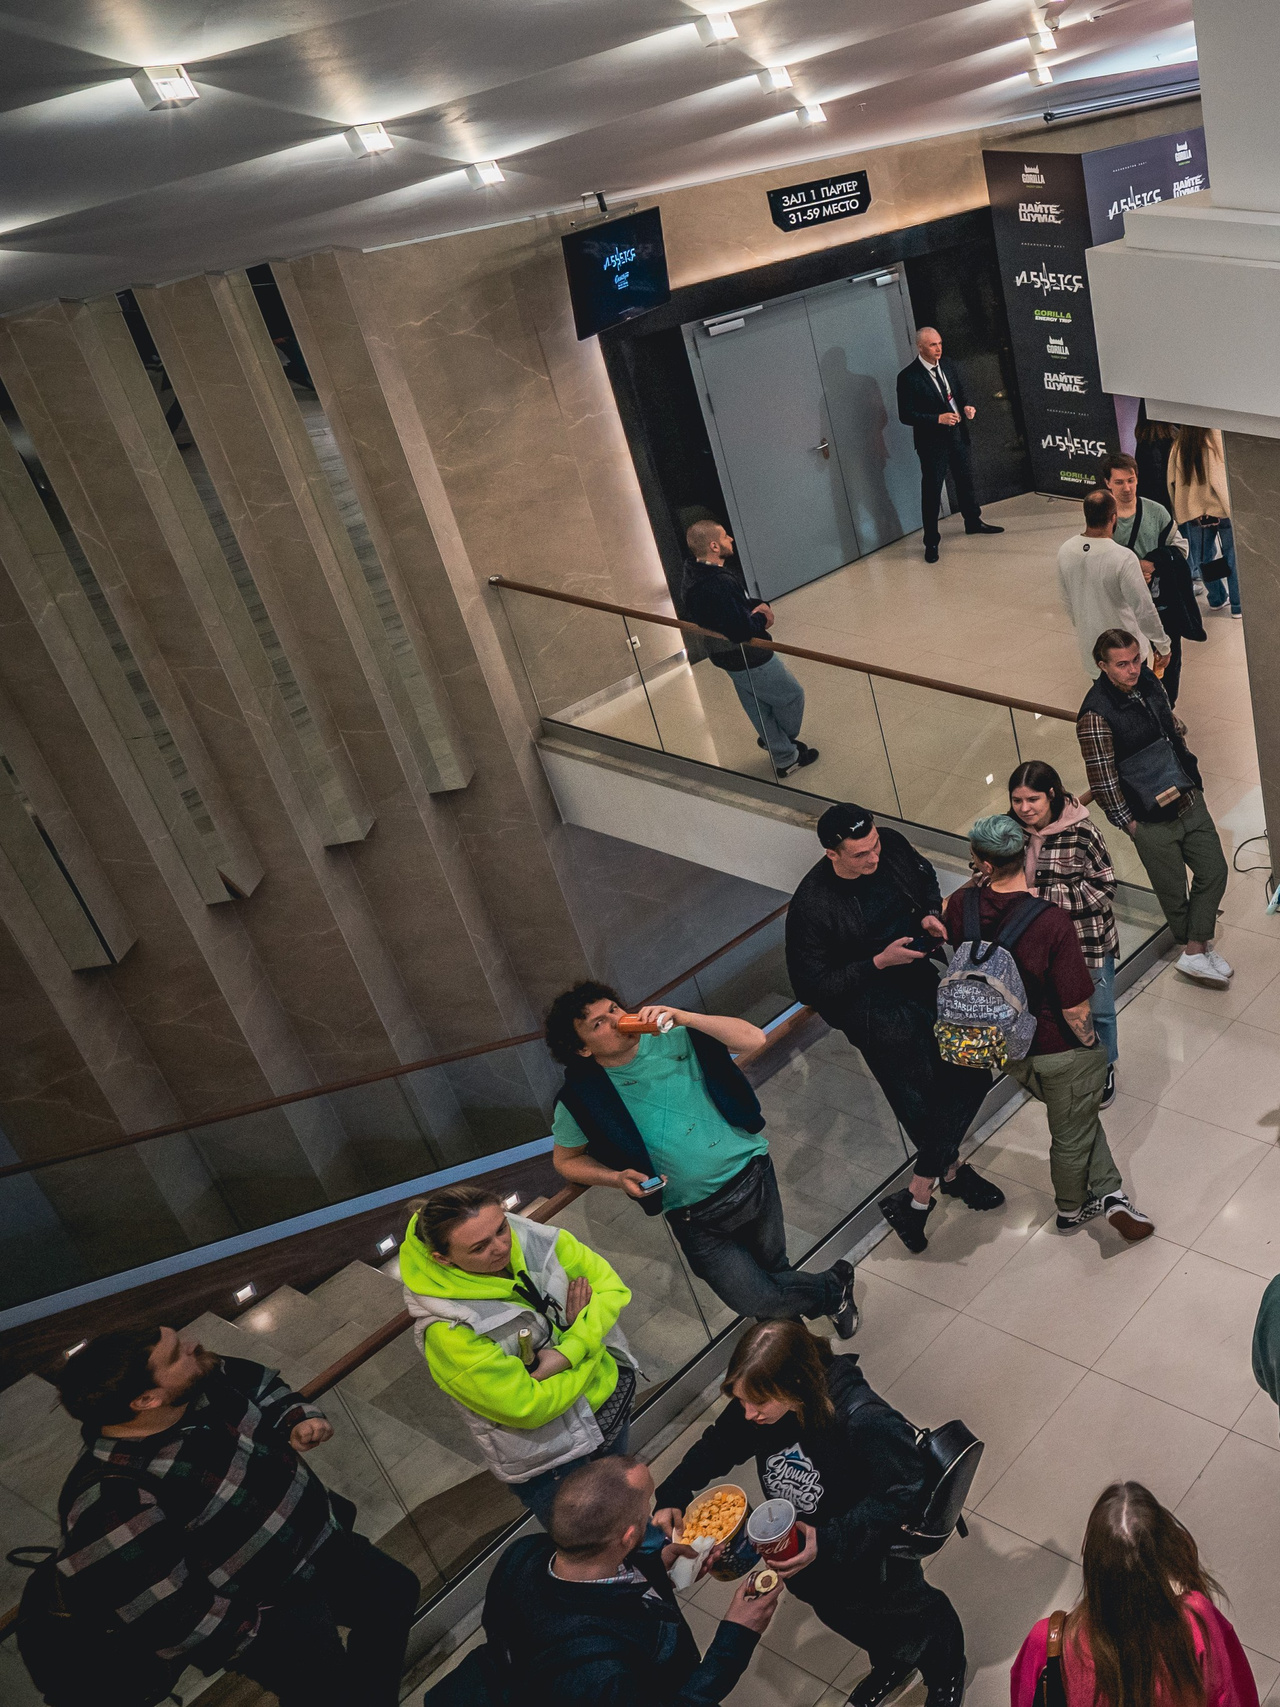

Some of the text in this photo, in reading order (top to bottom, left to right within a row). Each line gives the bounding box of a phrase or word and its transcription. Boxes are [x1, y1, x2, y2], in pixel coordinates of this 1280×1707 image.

[1022, 173, 1045, 184] GORILLA
[782, 180, 858, 207] ЗАЛ 1 ПАРТЕР
[788, 199, 860, 225] 31-59 МЕСТО
[1019, 202, 1063, 214] ДАЙТЕ
[1019, 211, 1063, 224] ШУМА
[1034, 309, 1072, 319] GORILLA
[1044, 372, 1087, 385] ДАЙТЕ
[1044, 380, 1087, 394] ШУМА
[1060, 470, 1096, 480] GORILLA
[767, 1456, 821, 1492] Young
